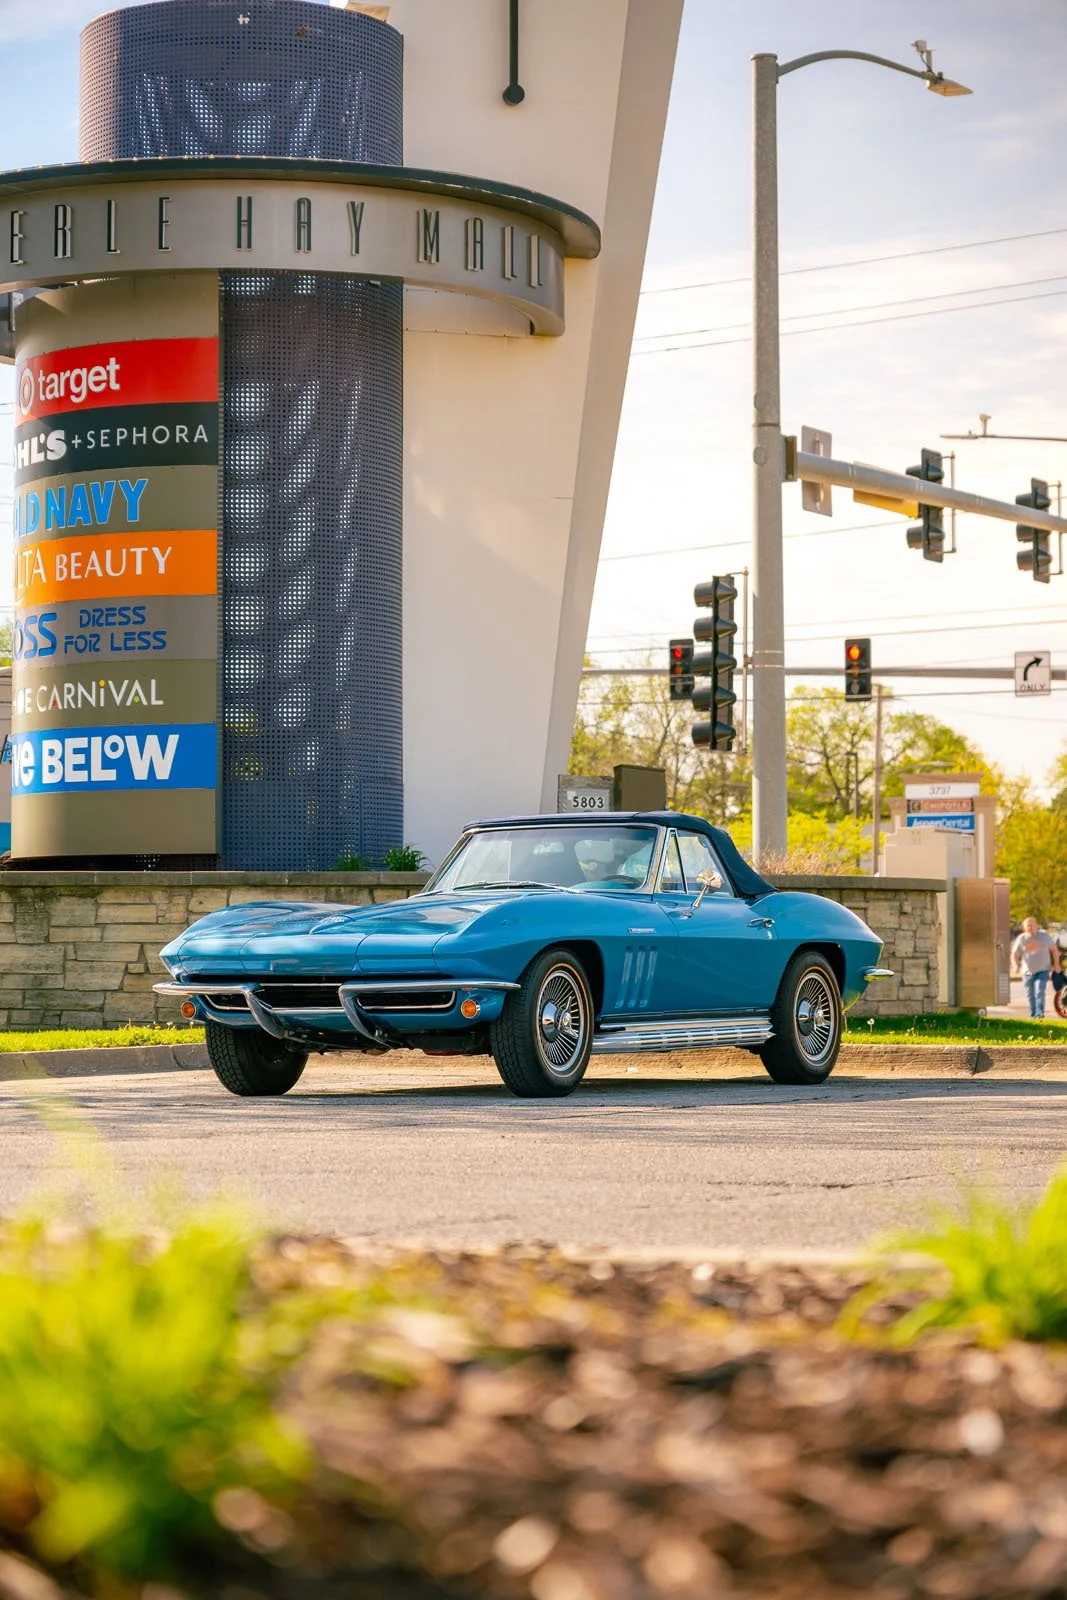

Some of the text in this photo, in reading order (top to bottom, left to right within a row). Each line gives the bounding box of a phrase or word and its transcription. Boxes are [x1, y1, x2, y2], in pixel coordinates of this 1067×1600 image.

[236, 195, 364, 256] HAY
[416, 208, 543, 289] MALL
[38, 357, 120, 403] target
[14, 429, 67, 472] HL'S
[45, 478, 149, 531] NAVY
[13, 546, 173, 590] LTA BEAUTY
[80, 606, 146, 628] DRESS
[64, 630, 167, 654] FOR LESS
[1020, 683, 1046, 693] ONLY
[41, 734, 181, 784] BELOW
[572, 796, 604, 809] 5803
[929, 786, 951, 795] 3737
